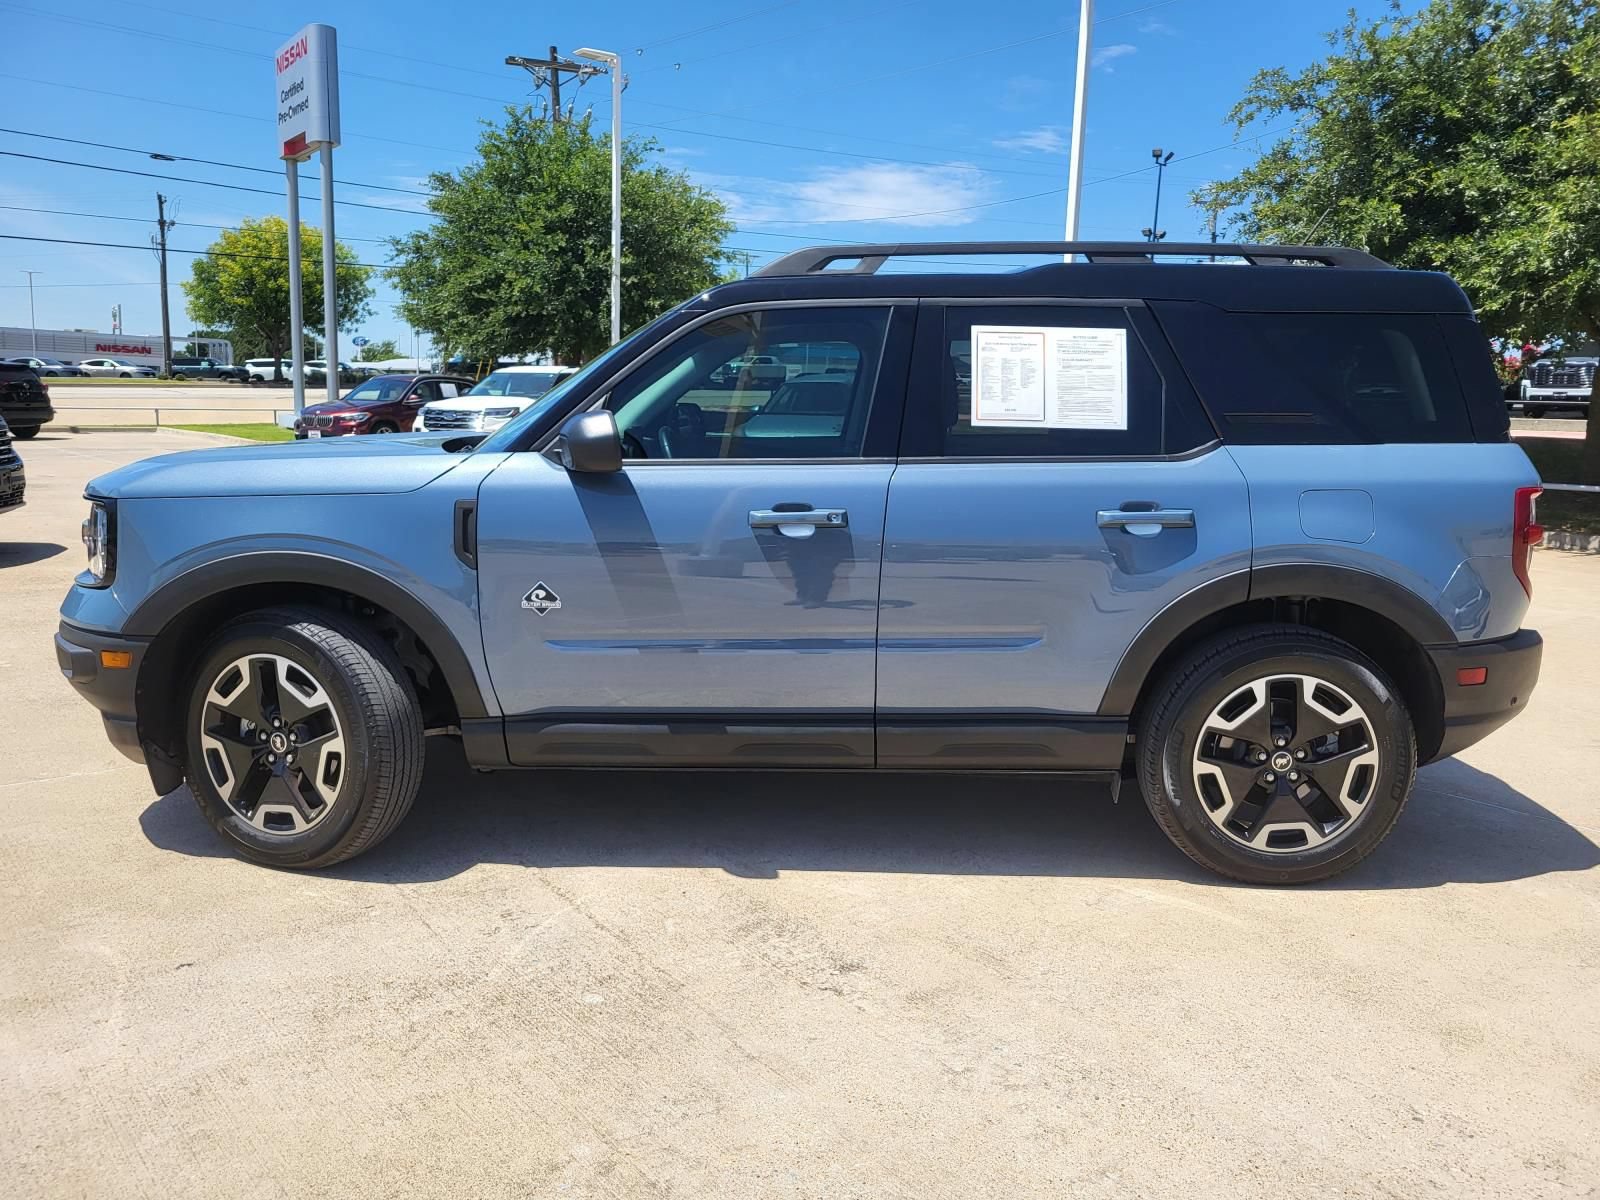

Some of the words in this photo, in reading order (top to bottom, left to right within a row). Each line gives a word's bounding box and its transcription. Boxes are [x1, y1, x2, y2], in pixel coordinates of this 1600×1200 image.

[276, 36, 307, 75] NISSAN
[280, 77, 304, 103] Certified
[278, 96, 309, 125] Pre-Owned
[95, 344, 152, 354] NISSAN
